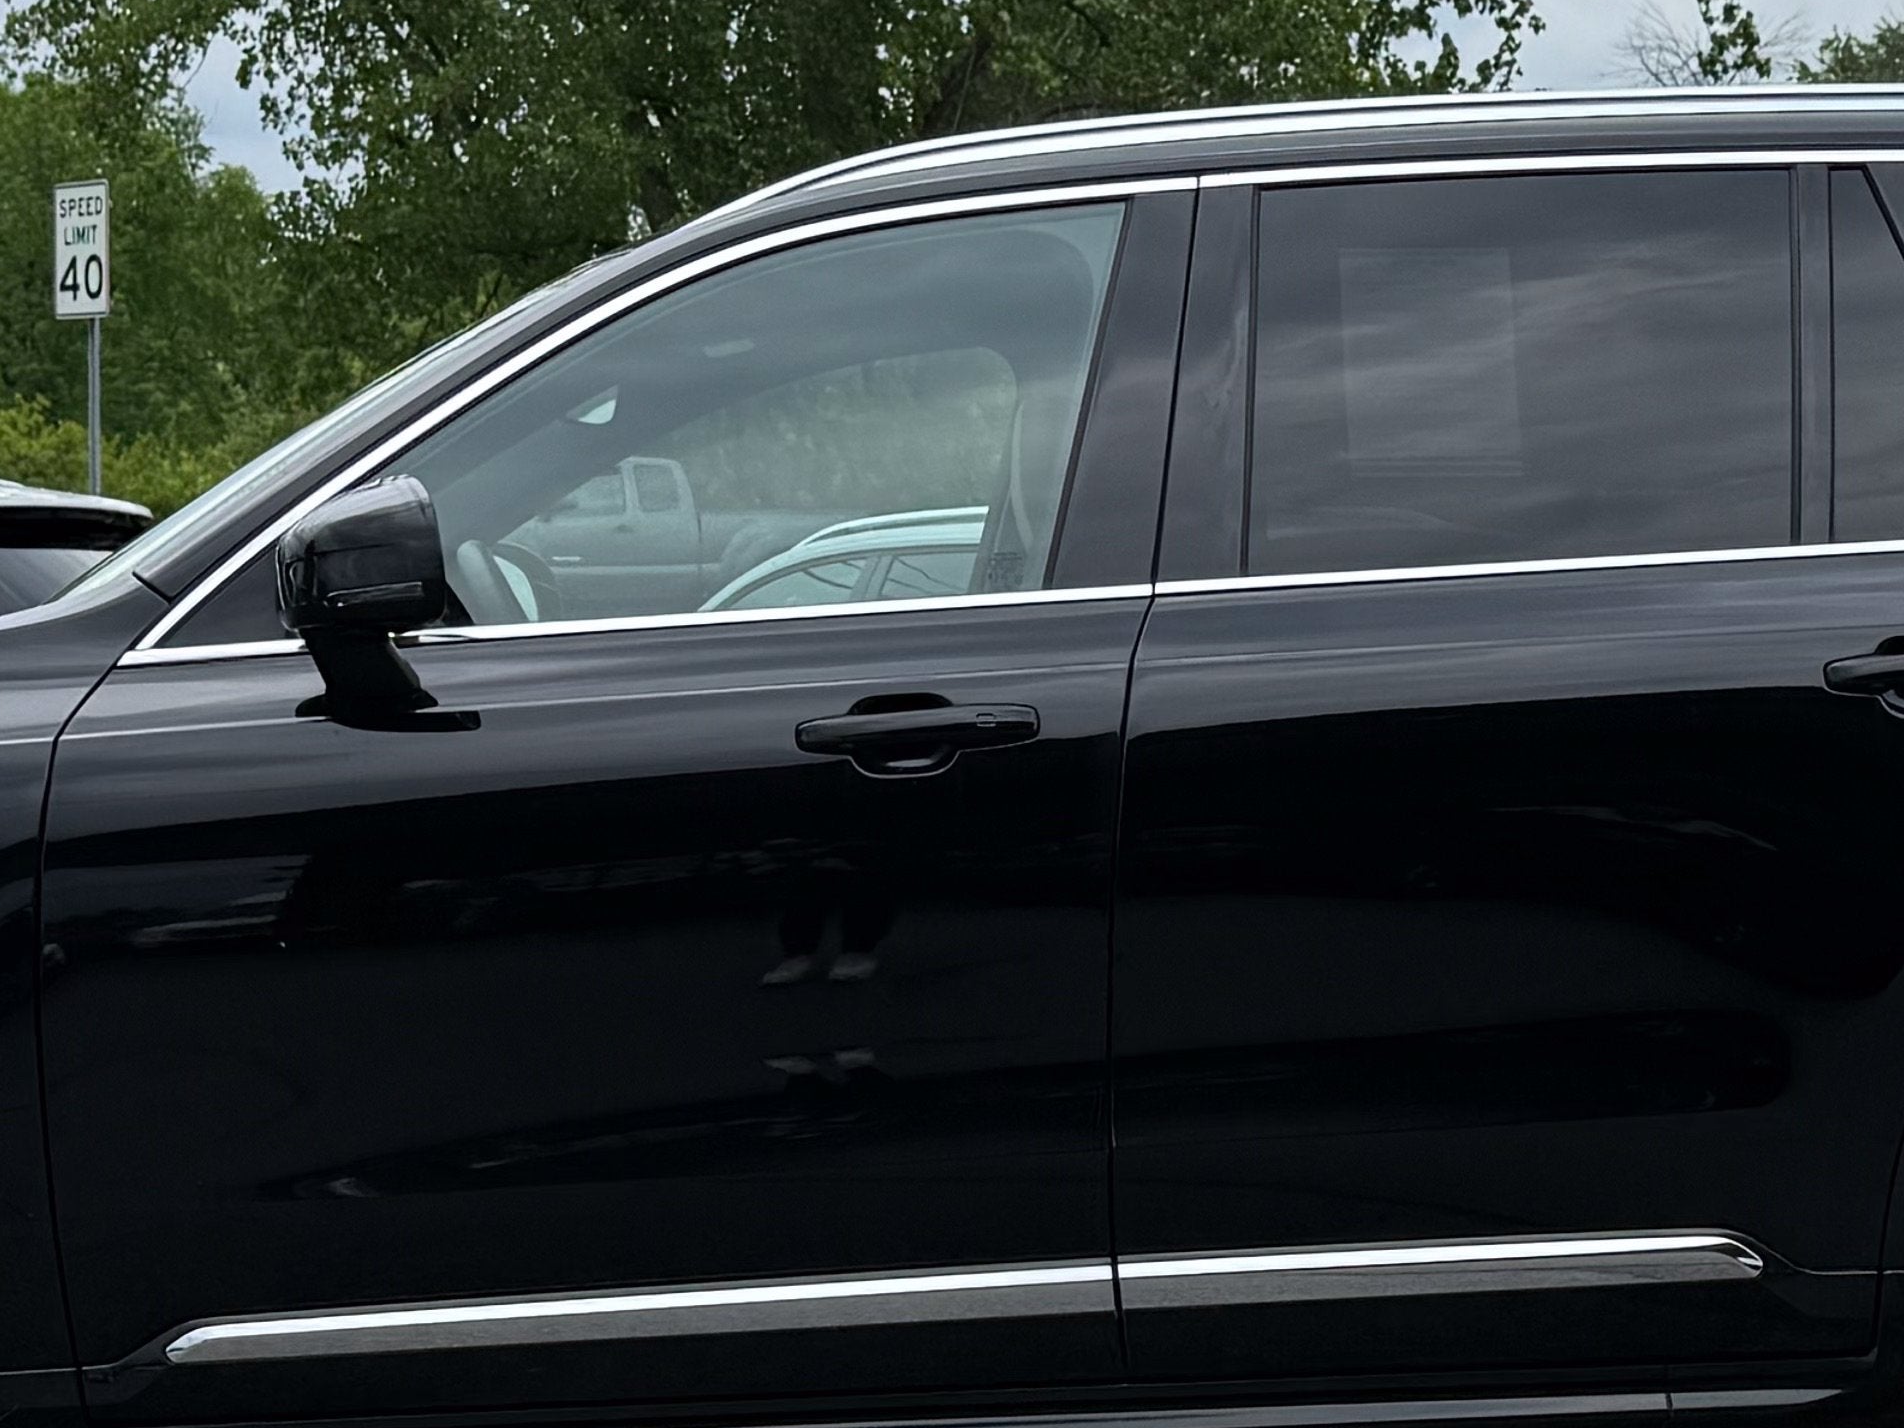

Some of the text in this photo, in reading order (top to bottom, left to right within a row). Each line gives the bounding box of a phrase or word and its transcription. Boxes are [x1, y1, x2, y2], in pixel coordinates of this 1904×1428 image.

[59, 196, 103, 218] SPEED
[64, 225, 97, 245] LIMIT
[59, 254, 103, 301] 40
